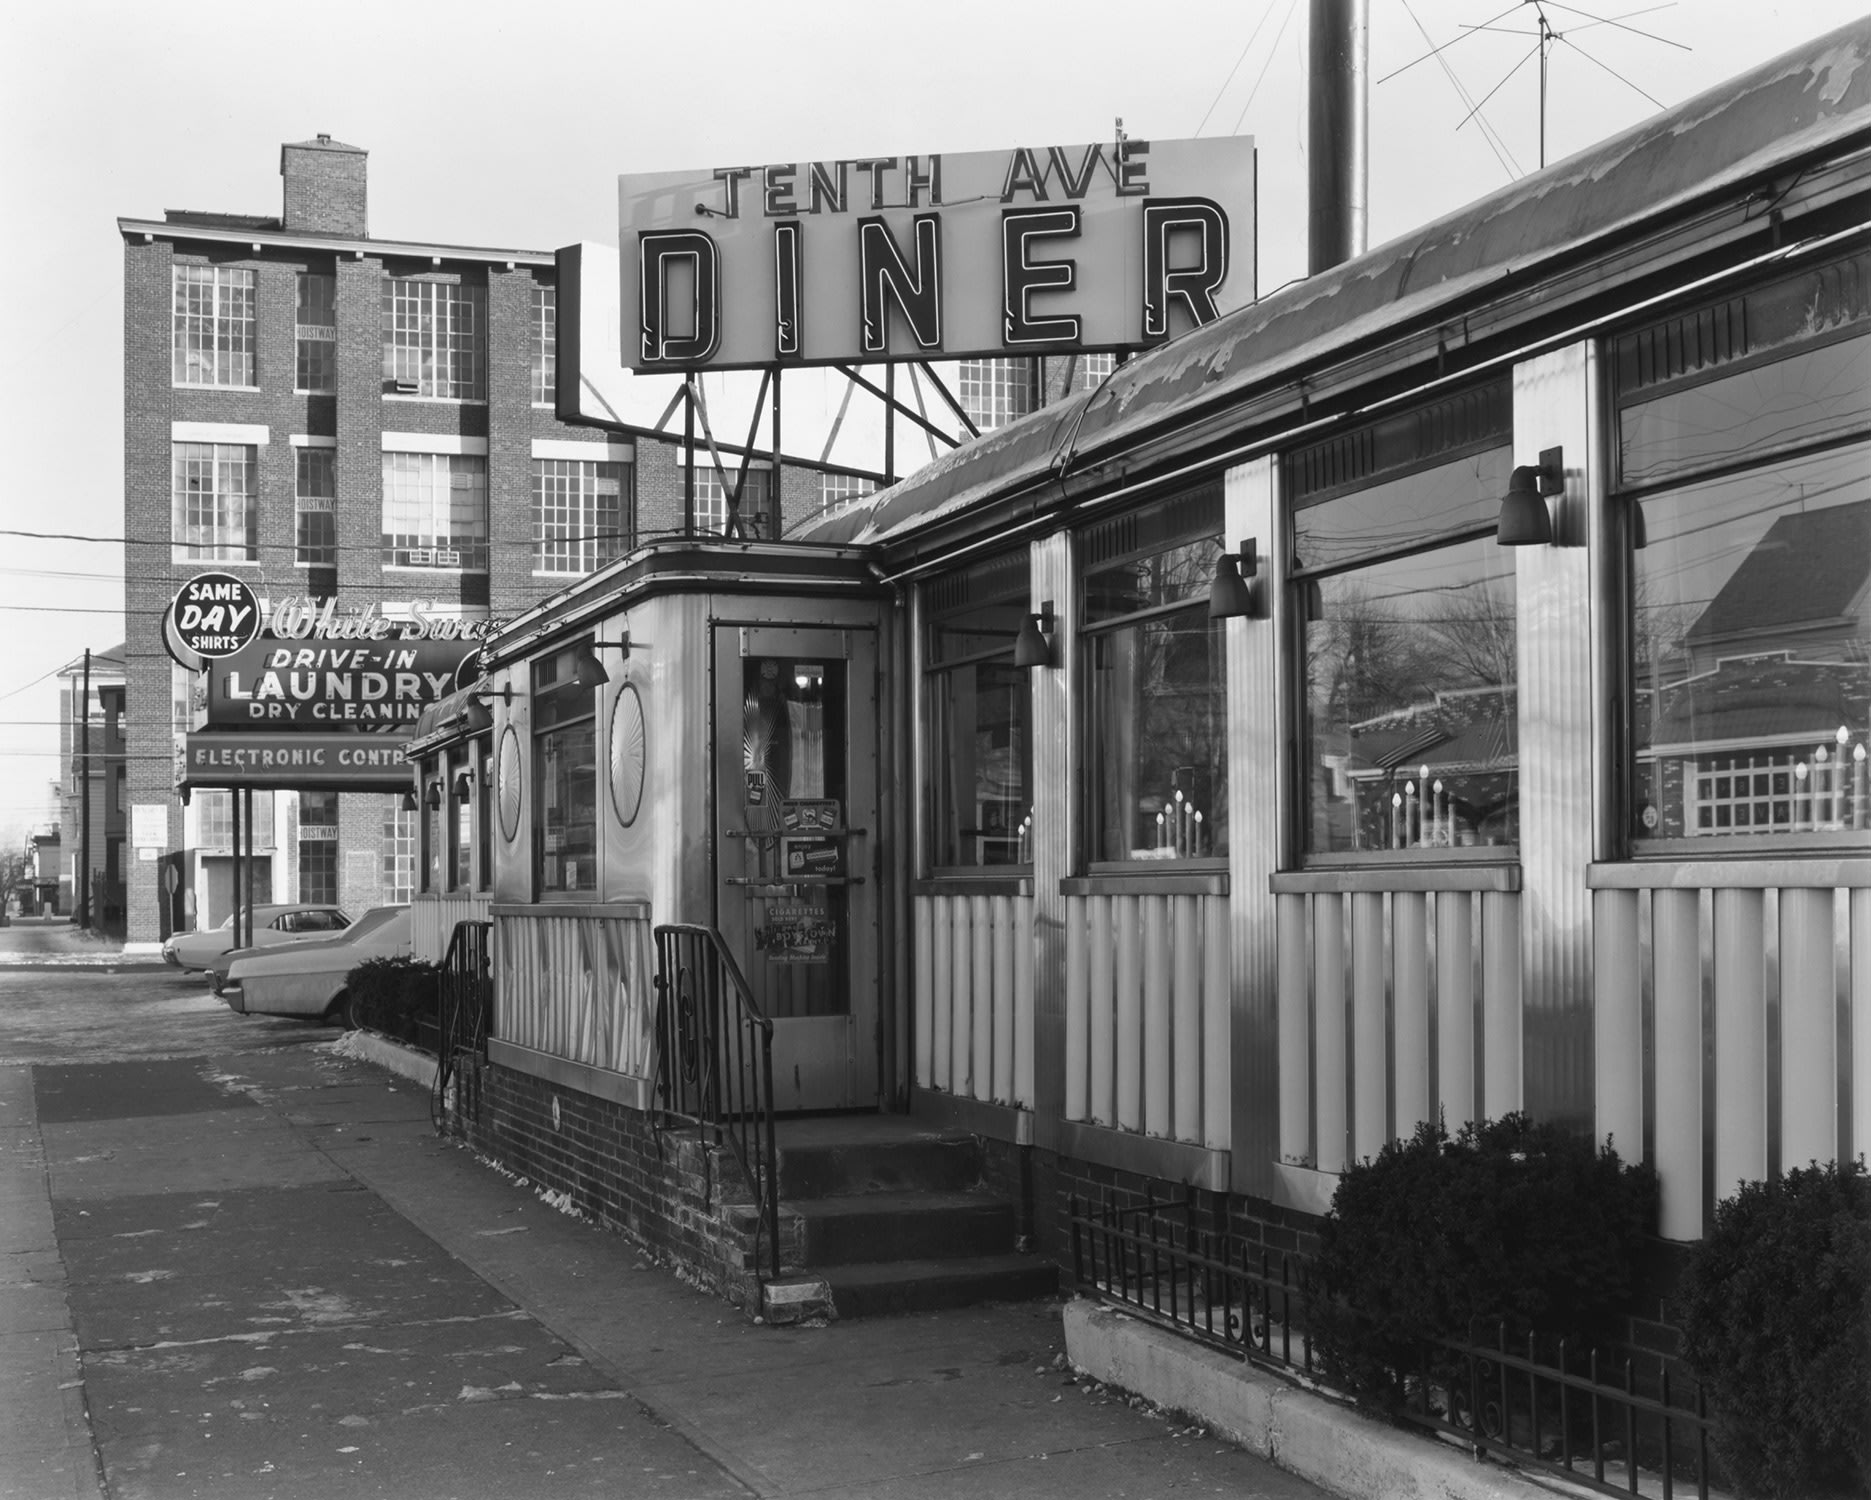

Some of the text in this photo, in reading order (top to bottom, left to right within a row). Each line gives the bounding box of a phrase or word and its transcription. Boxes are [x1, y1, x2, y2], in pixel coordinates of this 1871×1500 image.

[712, 140, 1151, 219] TENTH AVE
[638, 197, 1231, 365] DINER
[189, 583, 242, 601] SAME
[180, 604, 252, 633] DAY
[272, 596, 391, 640] White
[191, 635, 239, 650] SHIRTS
[270, 649, 417, 669] DRIVE-IN
[230, 672, 453, 700] LAUNDRY
[249, 703, 302, 719] DRY
[195, 748, 415, 766] ELECTRONIC CONTR
[748, 773, 765, 786] PULL
[769, 907, 824, 916] CIGARETTES
